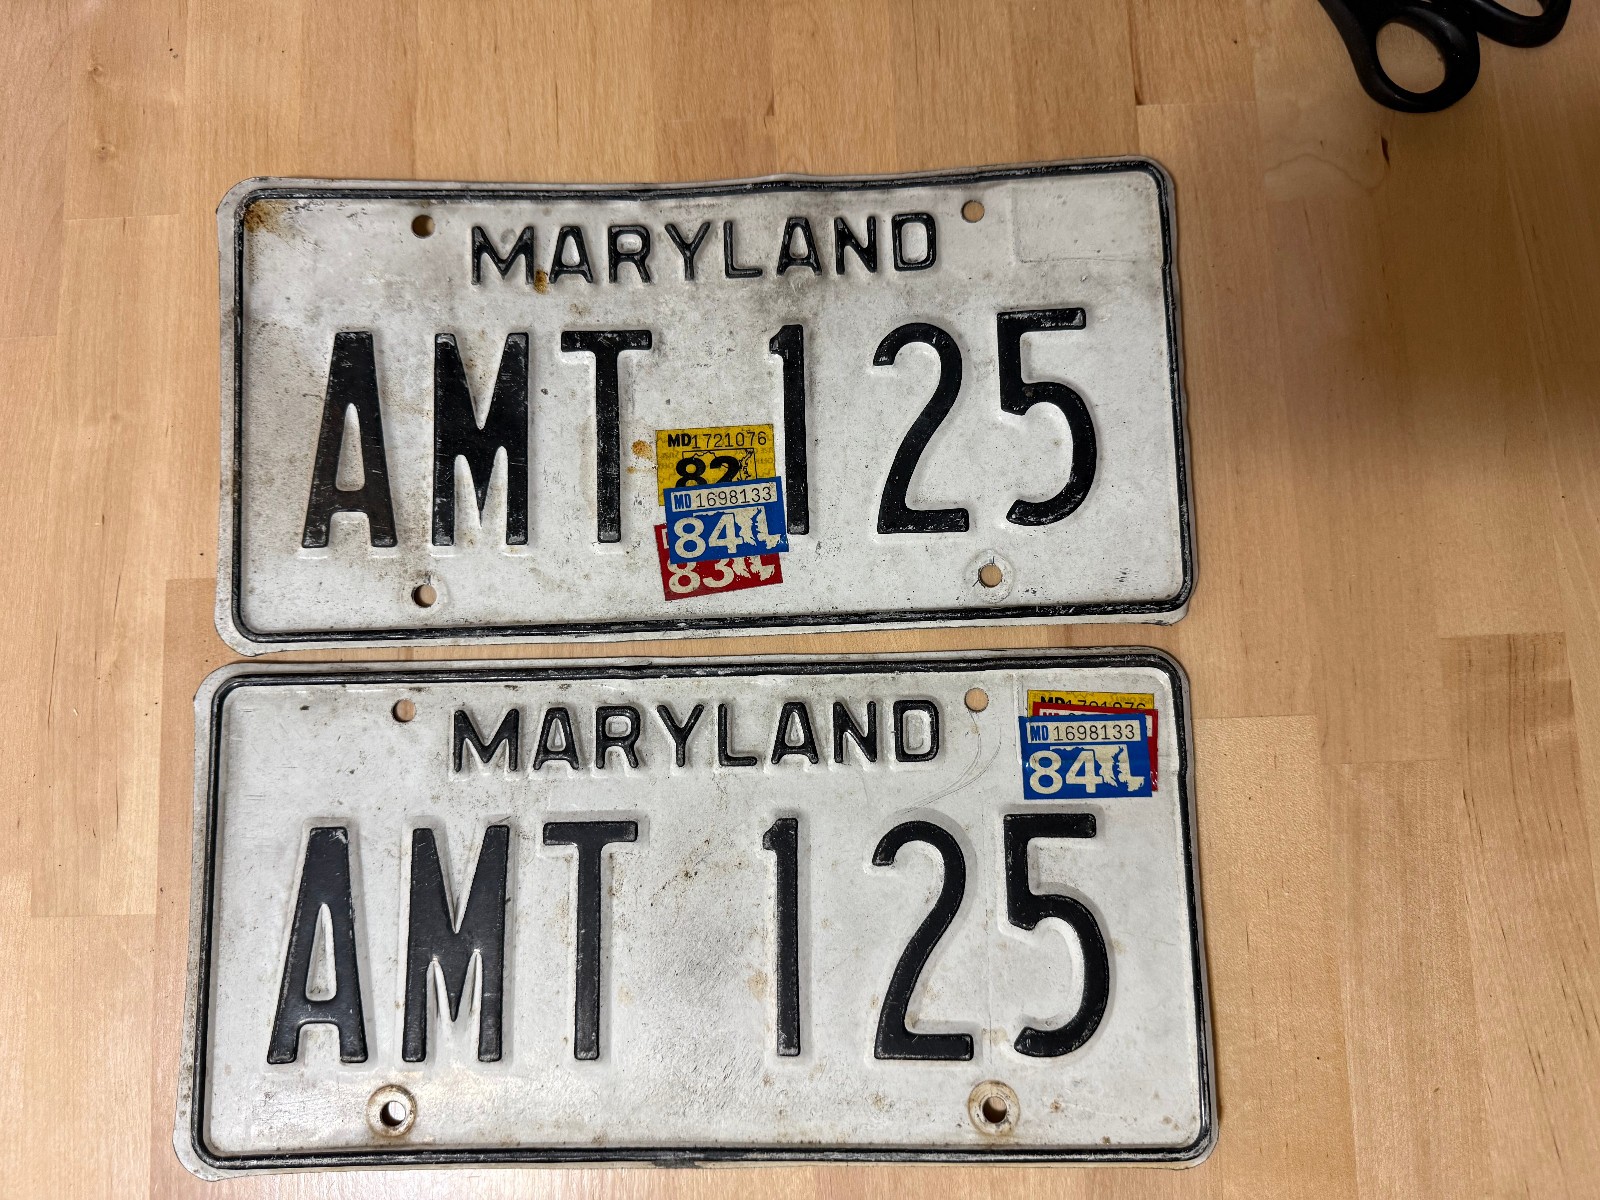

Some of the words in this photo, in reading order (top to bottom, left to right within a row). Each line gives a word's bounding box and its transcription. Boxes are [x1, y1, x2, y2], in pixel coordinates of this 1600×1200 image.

[470, 211, 938, 291] MARYLAND
[301, 329, 653, 549] AMT
[768, 306, 1098, 536] 125
[673, 493, 692, 510] MD
[695, 486, 773, 508] 1698133
[673, 513, 744, 559] 84
[452, 699, 940, 773] MARYLAND
[1029, 724, 1049, 742] MD
[1053, 723, 1136, 742] 1698133
[1028, 749, 1104, 795] 84
[266, 820, 639, 1065] AMT
[762, 812, 1111, 1062] 125
